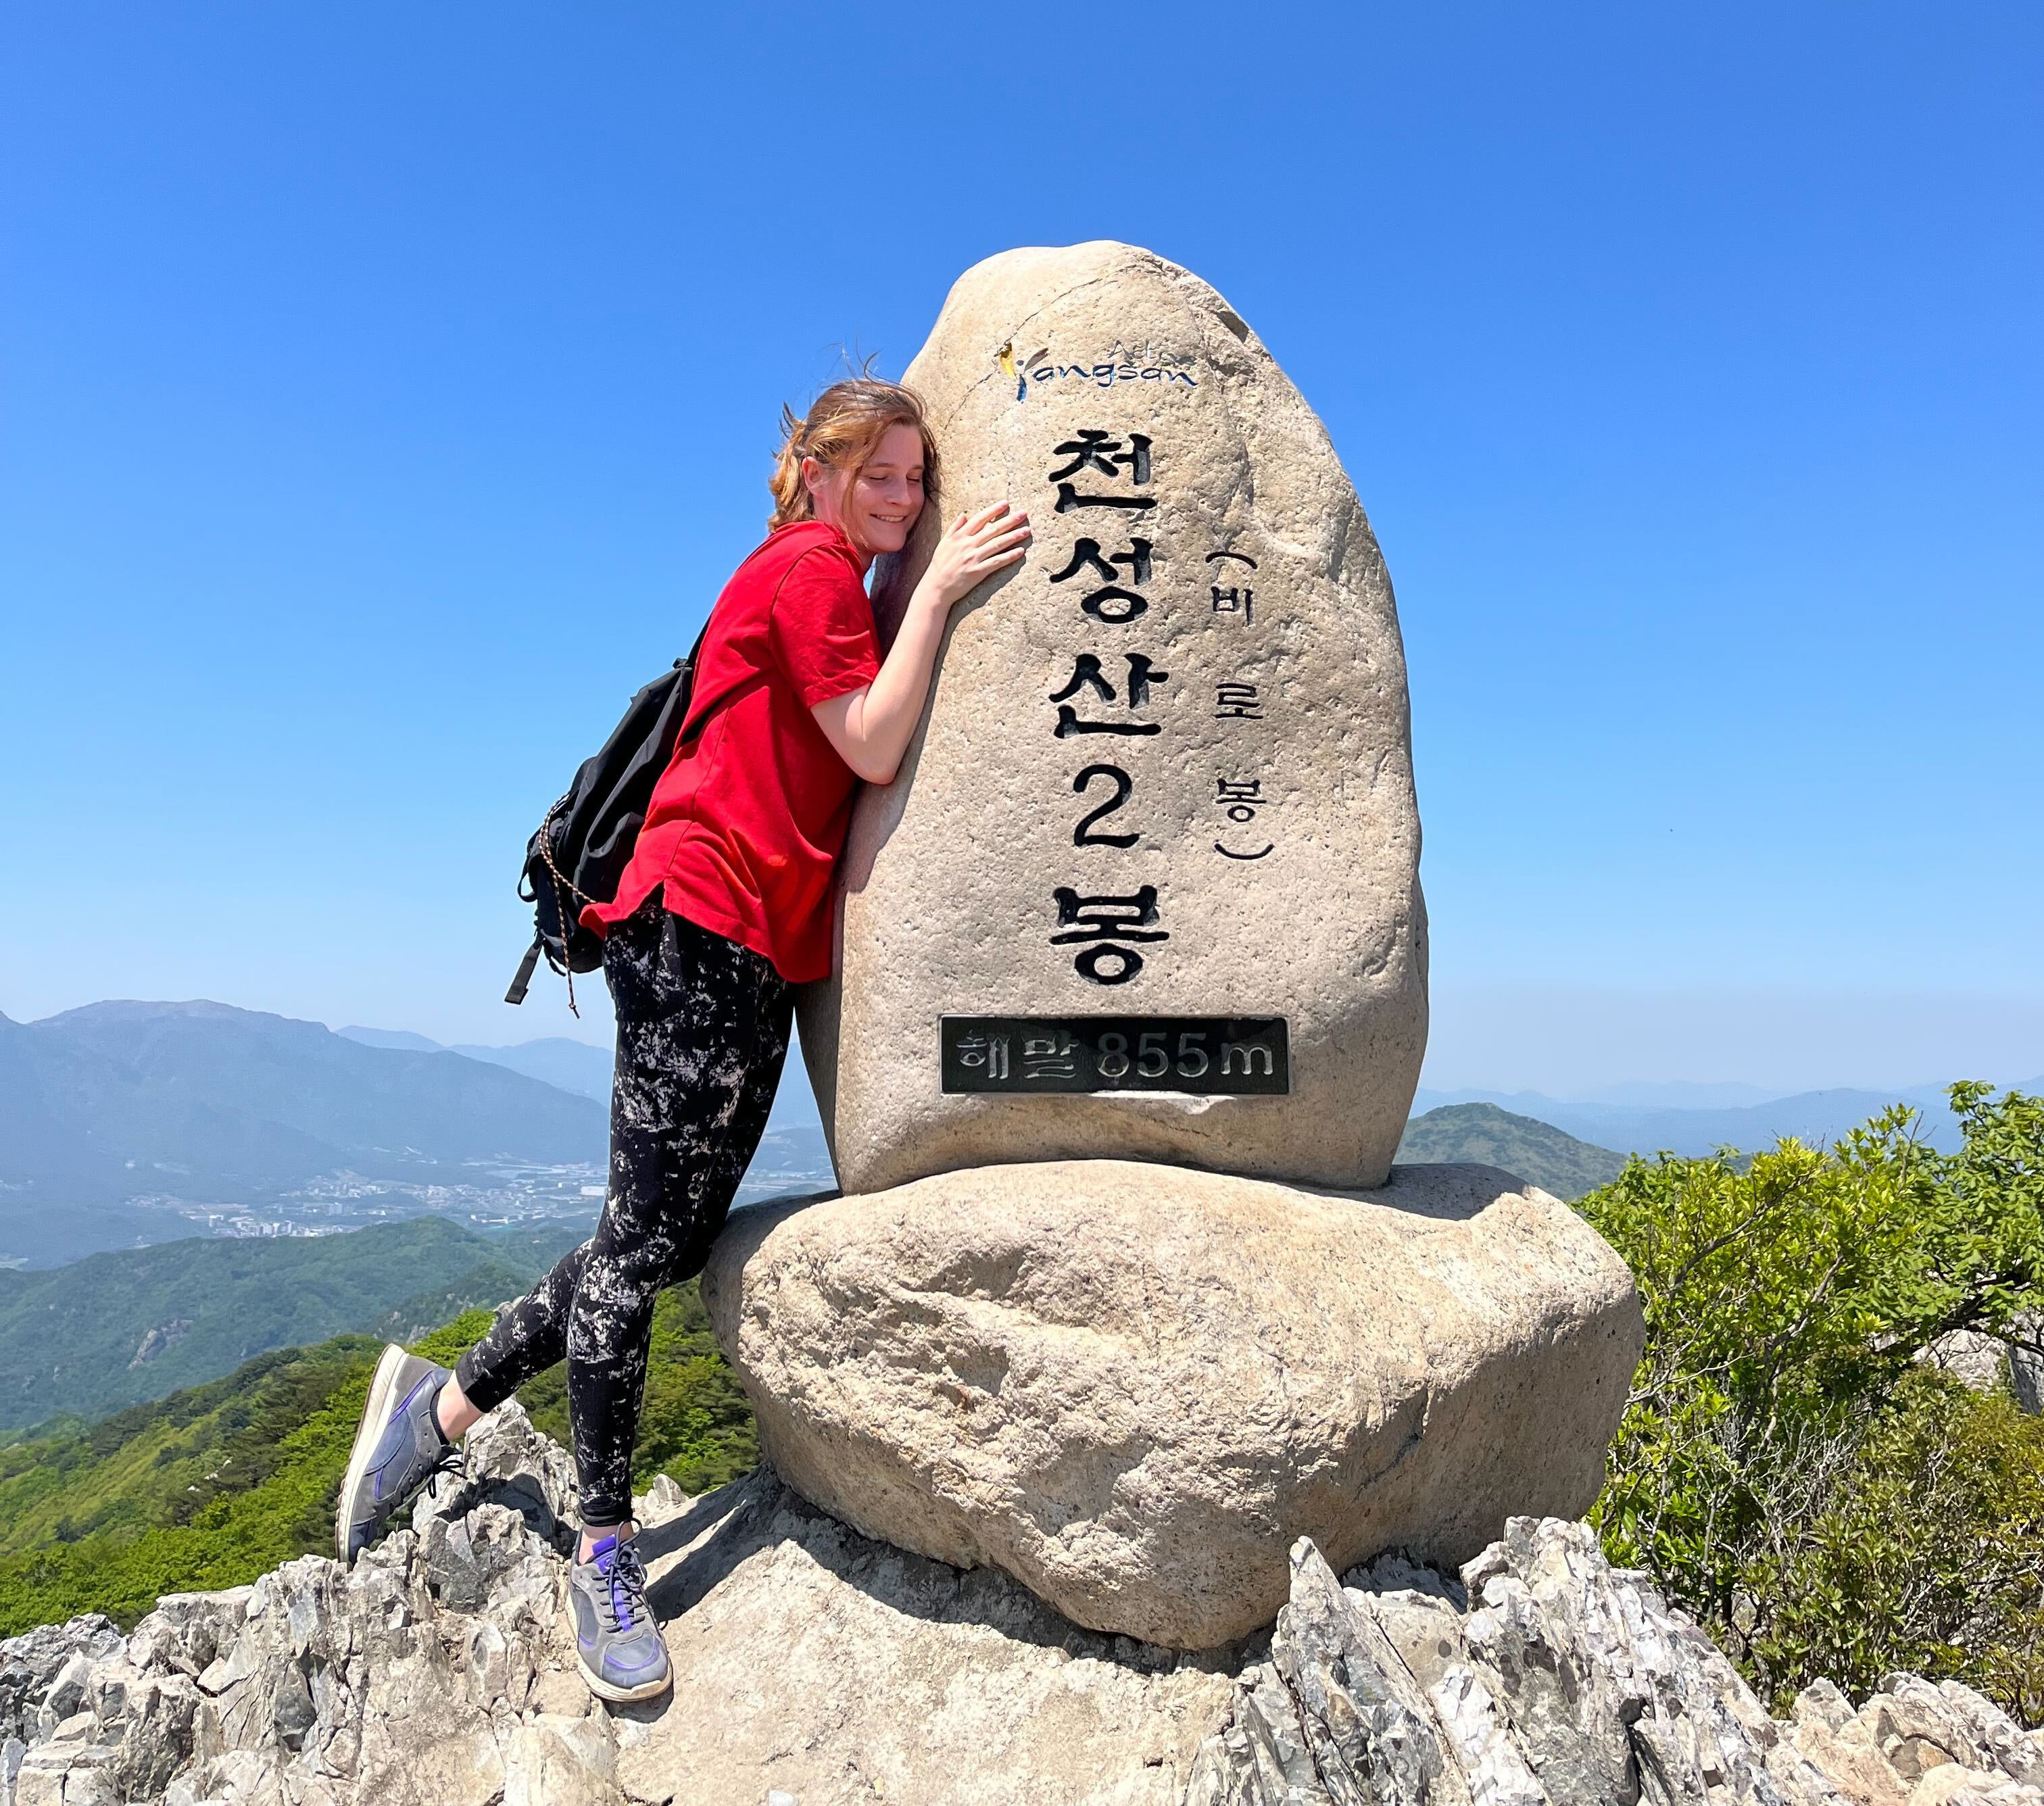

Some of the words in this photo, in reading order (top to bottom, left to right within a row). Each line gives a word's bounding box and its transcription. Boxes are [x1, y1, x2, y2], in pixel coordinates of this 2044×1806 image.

[996, 342, 1198, 402] Yangsan
[1048, 429, 1170, 985] 천성산2봉
[956, 1029, 1080, 1080] 해발
[1096, 1031, 1273, 1079] 855m
